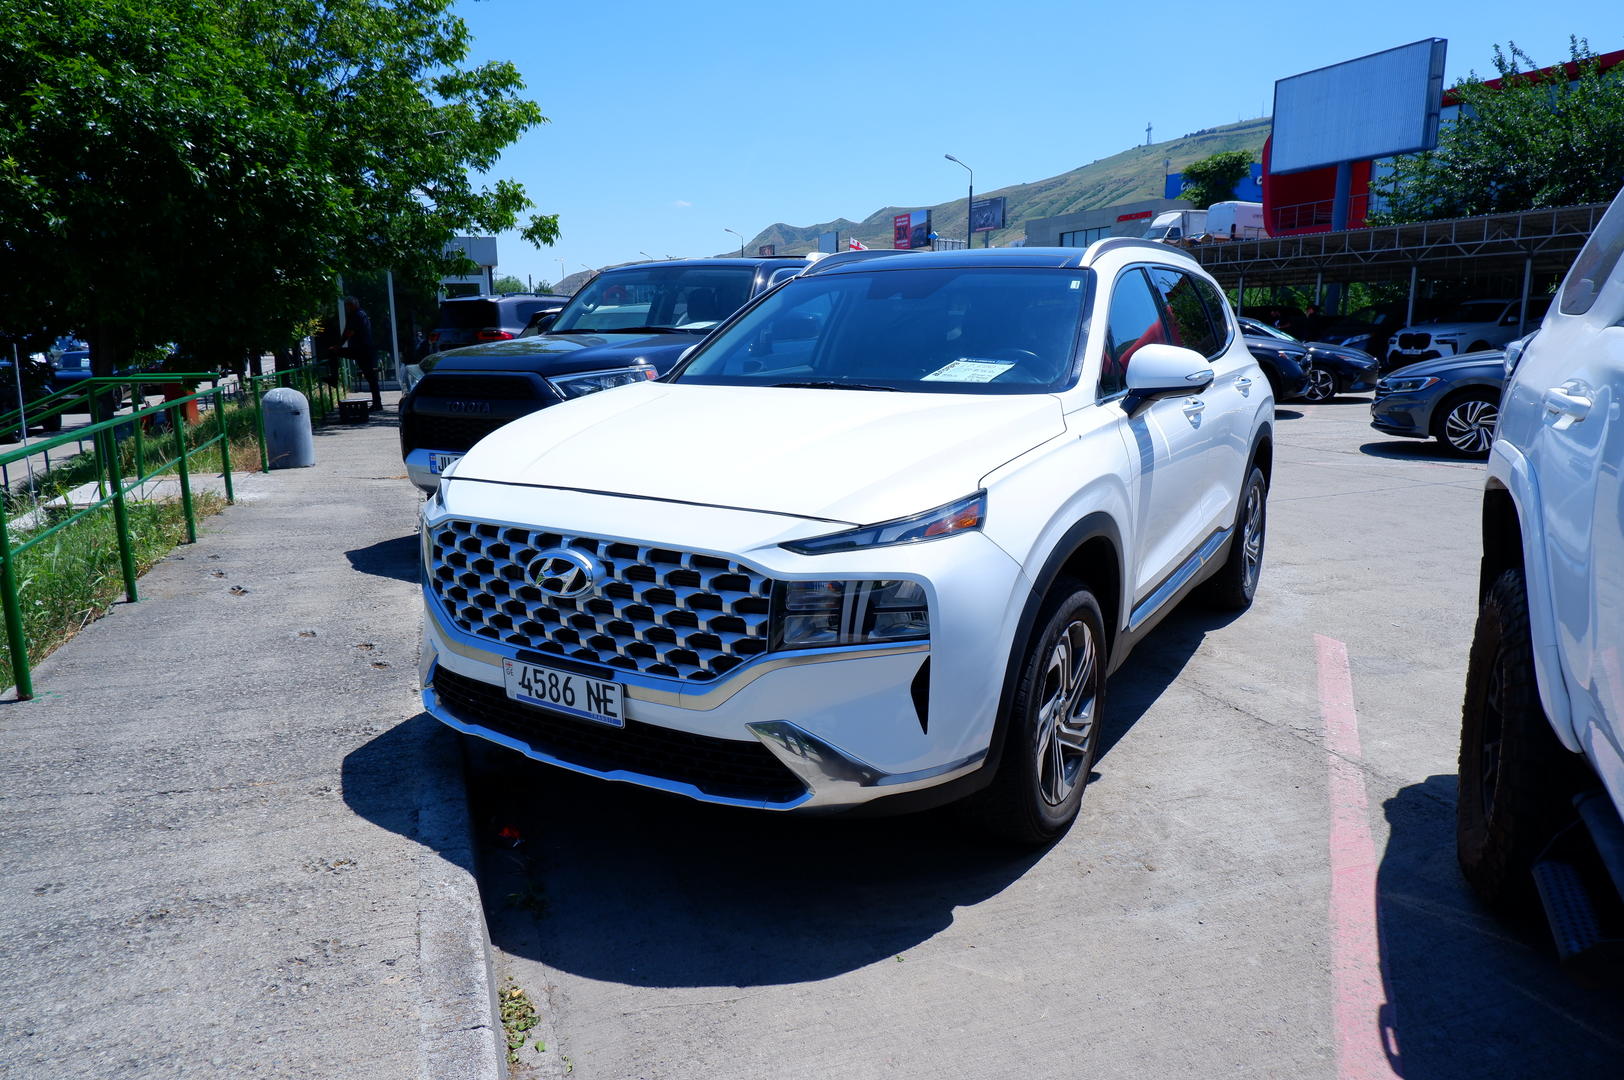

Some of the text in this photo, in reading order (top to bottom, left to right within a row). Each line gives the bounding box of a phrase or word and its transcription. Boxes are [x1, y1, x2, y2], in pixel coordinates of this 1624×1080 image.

[446, 401, 490, 414] TOYOTA
[518, 666, 618, 718] 4586 NE
